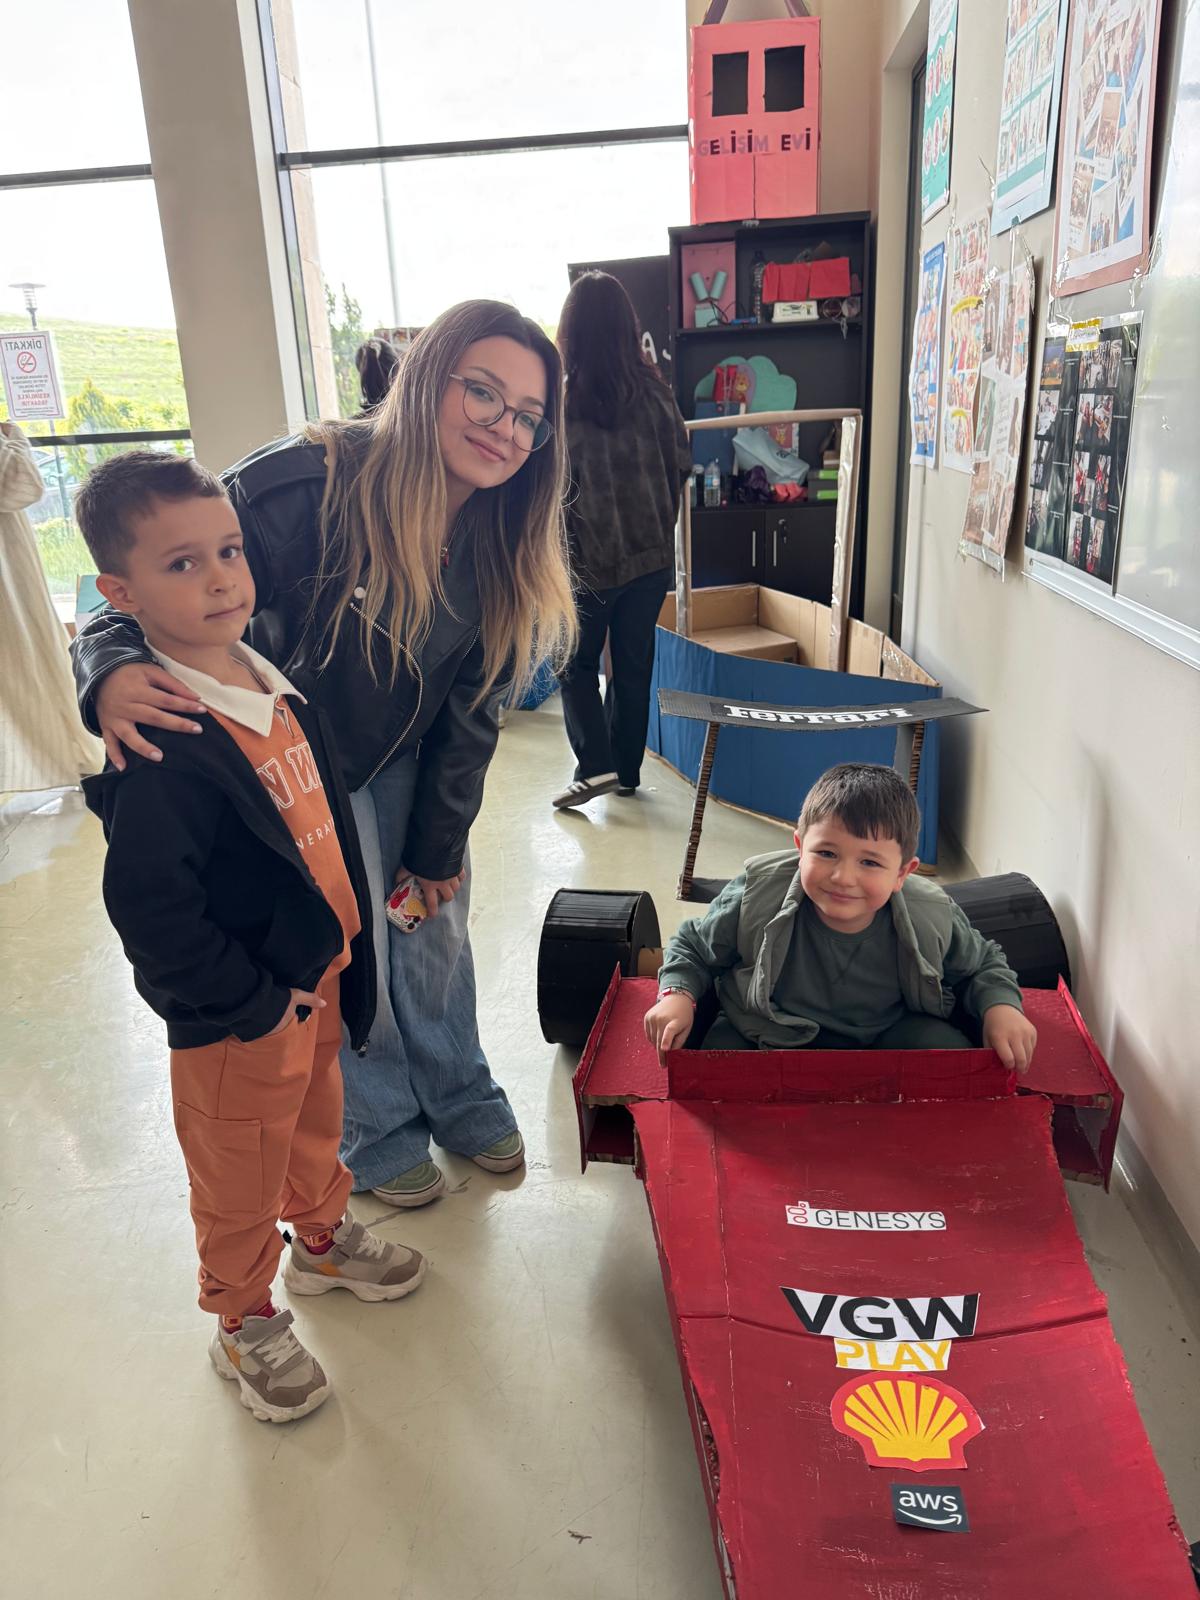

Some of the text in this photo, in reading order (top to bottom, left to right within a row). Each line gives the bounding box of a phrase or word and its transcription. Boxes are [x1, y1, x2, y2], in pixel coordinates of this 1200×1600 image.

[723, 704, 913, 724] Ferrari
[815, 1209, 946, 1230] GENESYS
[781, 1287, 979, 1341] VGW
[835, 1340, 950, 1371] PLAY
[899, 1490, 958, 1512] aws
